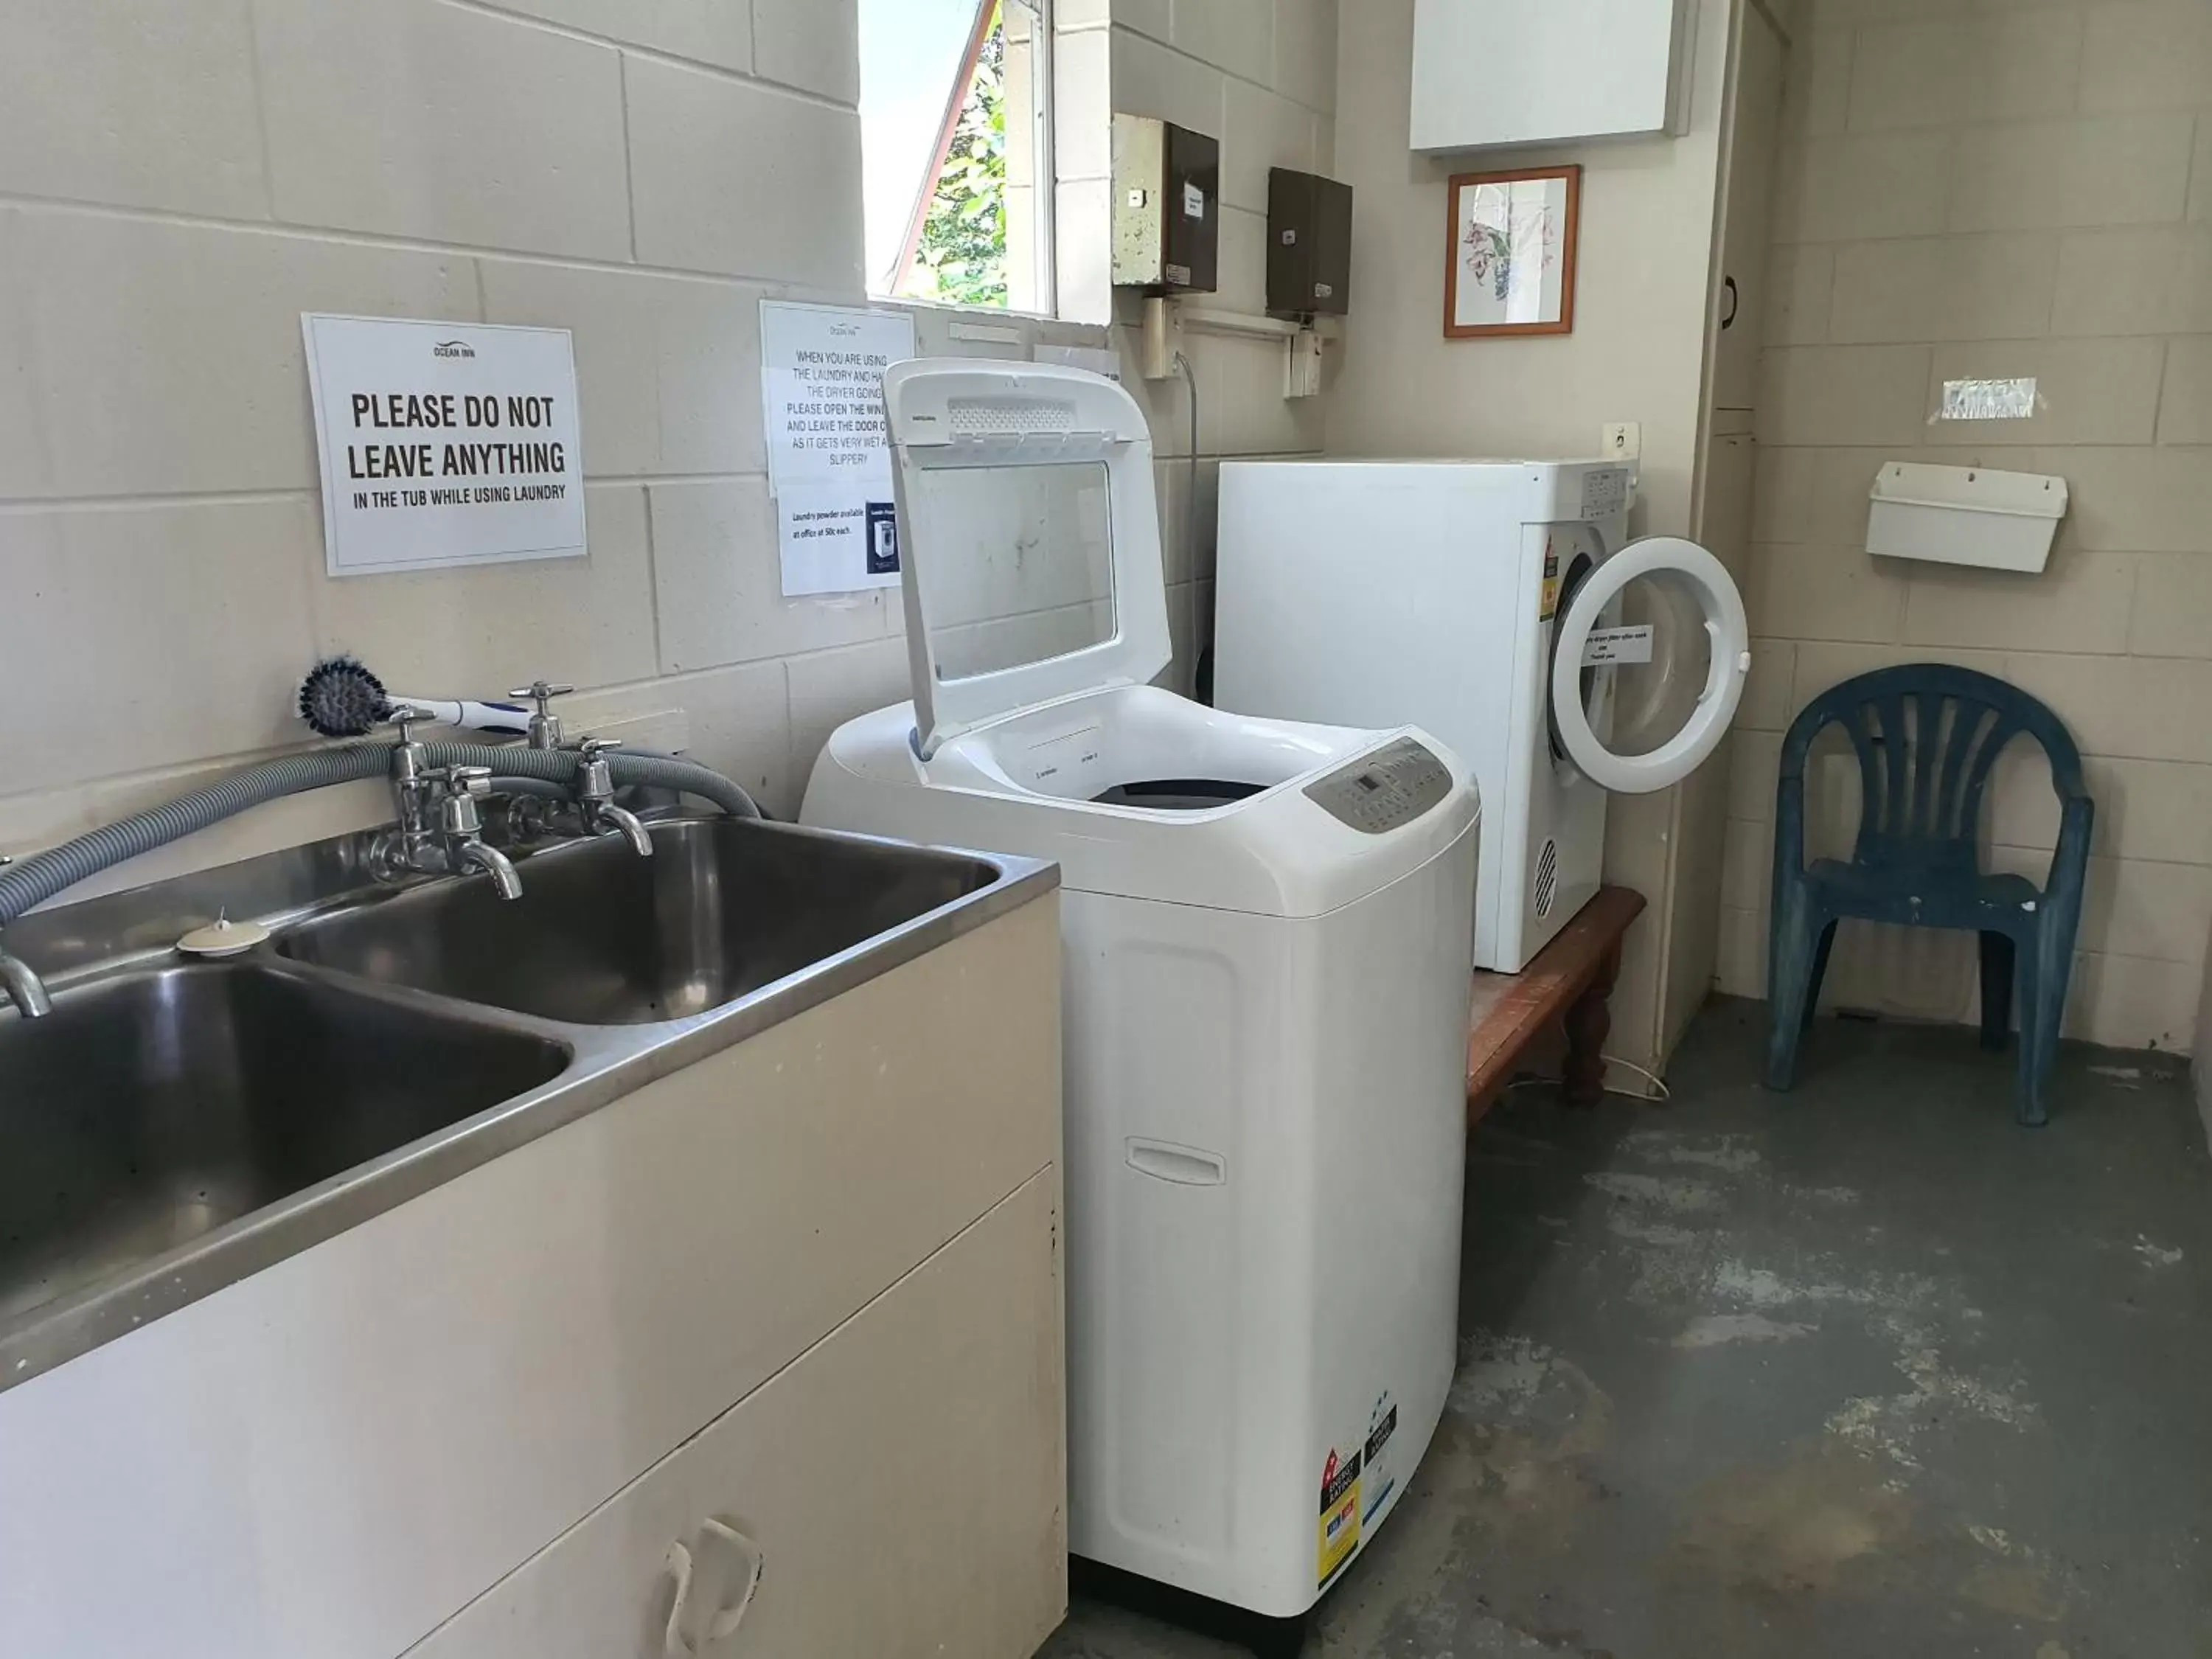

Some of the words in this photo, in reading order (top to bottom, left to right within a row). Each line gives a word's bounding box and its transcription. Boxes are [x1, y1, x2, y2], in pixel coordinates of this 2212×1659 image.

[434, 347, 459, 357] OCEAN
[462, 348, 476, 358] INN
[796, 350, 824, 364] WHEN
[825, 352, 843, 365] YOU
[844, 354, 862, 366] ARE
[863, 355, 887, 366] USING
[793, 368, 810, 380] THE
[813, 369, 852, 381] LAUNDRY
[853, 371, 870, 383] AND
[807, 386, 824, 398] THE
[825, 386, 855, 399] DRYER
[352, 393, 456, 428] PLEASE
[465, 395, 499, 428] DO
[508, 396, 554, 428] NOT
[787, 403, 822, 414] PLEASE
[824, 403, 847, 414] OPEN
[849, 403, 864, 414] THE
[787, 420, 806, 432] AND
[808, 420, 835, 431] LEAVE
[838, 420, 854, 431] THE
[855, 420, 878, 431] DOOR
[793, 437, 804, 449] AS
[806, 437, 815, 448] IT
[816, 437, 839, 449] GETS
[841, 437, 861, 448] VERY
[863, 437, 880, 448] WET
[348, 445, 434, 479] LEAVE
[442, 442, 566, 476] ANYTHING
[830, 453, 869, 465] SLIPPERY
[354, 493, 367, 509] IN
[372, 492, 397, 508] THE
[402, 490, 427, 506] TUB
[431, 488, 470, 505] WHILE
[474, 487, 510, 504] USING
[514, 484, 566, 501] LAUNDRY
[793, 512, 815, 521] Laundry
[816, 510, 839, 521] powder
[801, 529, 816, 538] office
